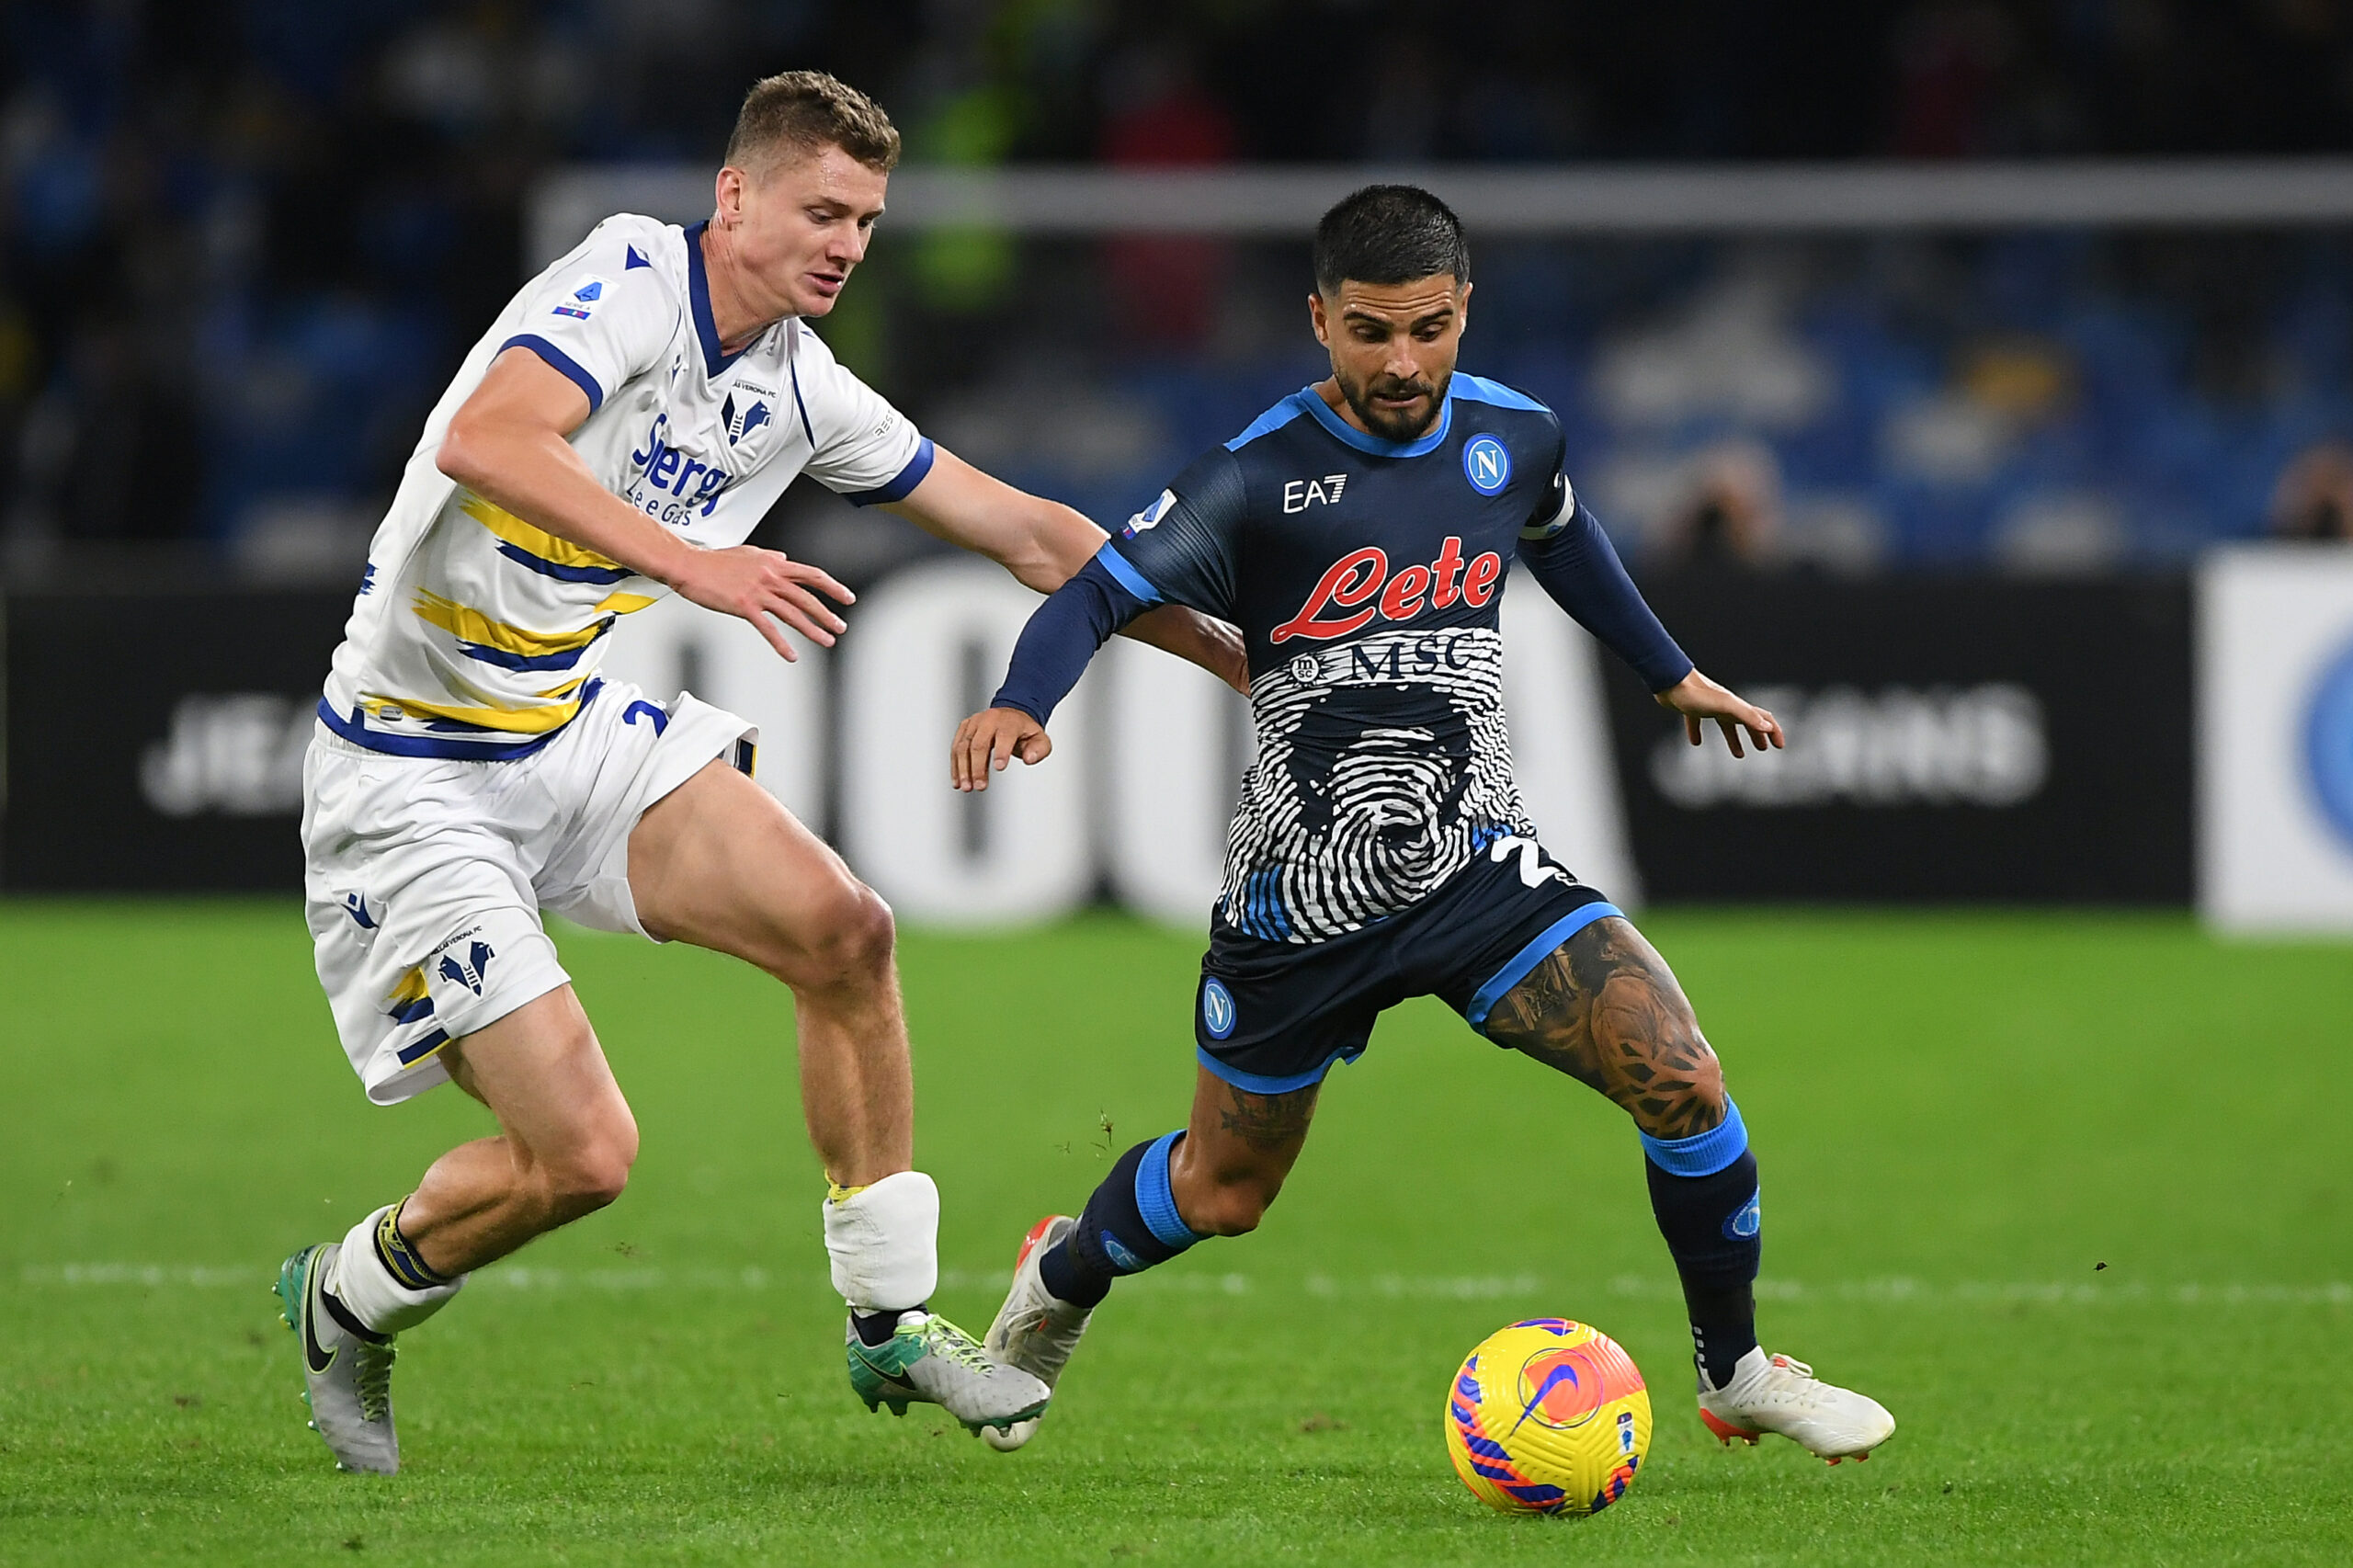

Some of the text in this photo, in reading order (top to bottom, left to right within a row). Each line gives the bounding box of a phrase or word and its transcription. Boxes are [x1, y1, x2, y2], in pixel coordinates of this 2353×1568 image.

[741, 382, 767, 396] VERONA
[1475, 449, 1499, 480] N
[1283, 473, 1347, 514] EA7
[1270, 536, 1502, 644] Lete
[1350, 631, 1475, 680] MSC
[1208, 989, 1226, 1026] N
